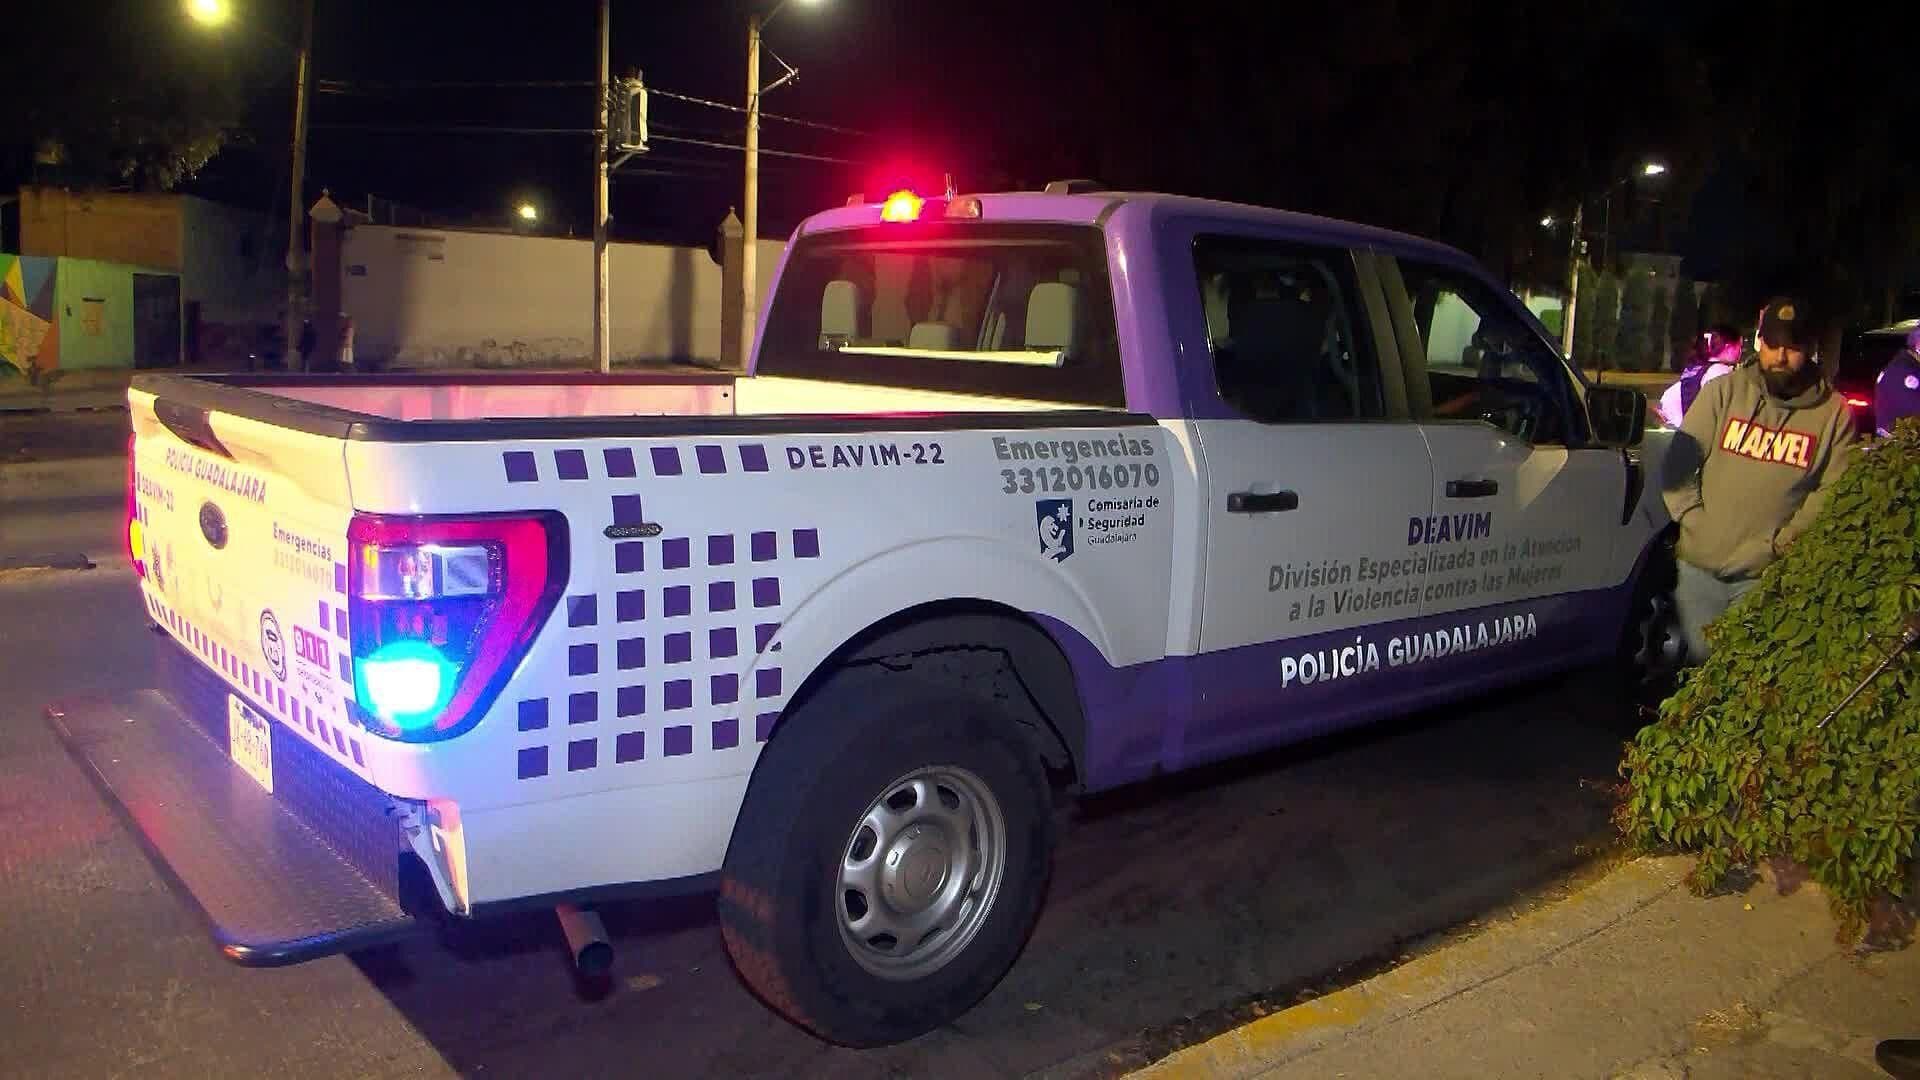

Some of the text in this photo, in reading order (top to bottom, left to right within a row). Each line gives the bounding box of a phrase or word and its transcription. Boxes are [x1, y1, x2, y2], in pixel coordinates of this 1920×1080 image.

[785, 442, 945, 470] DEAVIM-22
[992, 432, 1154, 463] Emergencias
[1722, 419, 1810, 468] MARVEL
[195, 459, 266, 504] GUADALAJARA
[1000, 463, 1160, 495] 3312016070
[1088, 496, 1160, 512] Comisaría de
[1088, 514, 1144, 532] Seguridad
[1088, 533, 1137, 545] Guadalajara
[1408, 512, 1491, 546] DEAVIM
[273, 521, 332, 562] Emergencias
[1268, 559, 1351, 592] División
[1357, 547, 1475, 584] Especializada
[1481, 549, 1498, 566] en
[1289, 601, 1301, 621] a
[1308, 594, 1325, 618] la
[1333, 582, 1418, 614] Violencia
[1424, 576, 1477, 602] contra
[1482, 570, 1503, 592] las
[1280, 613, 1537, 688] POLICÍA GUADALAJARA
